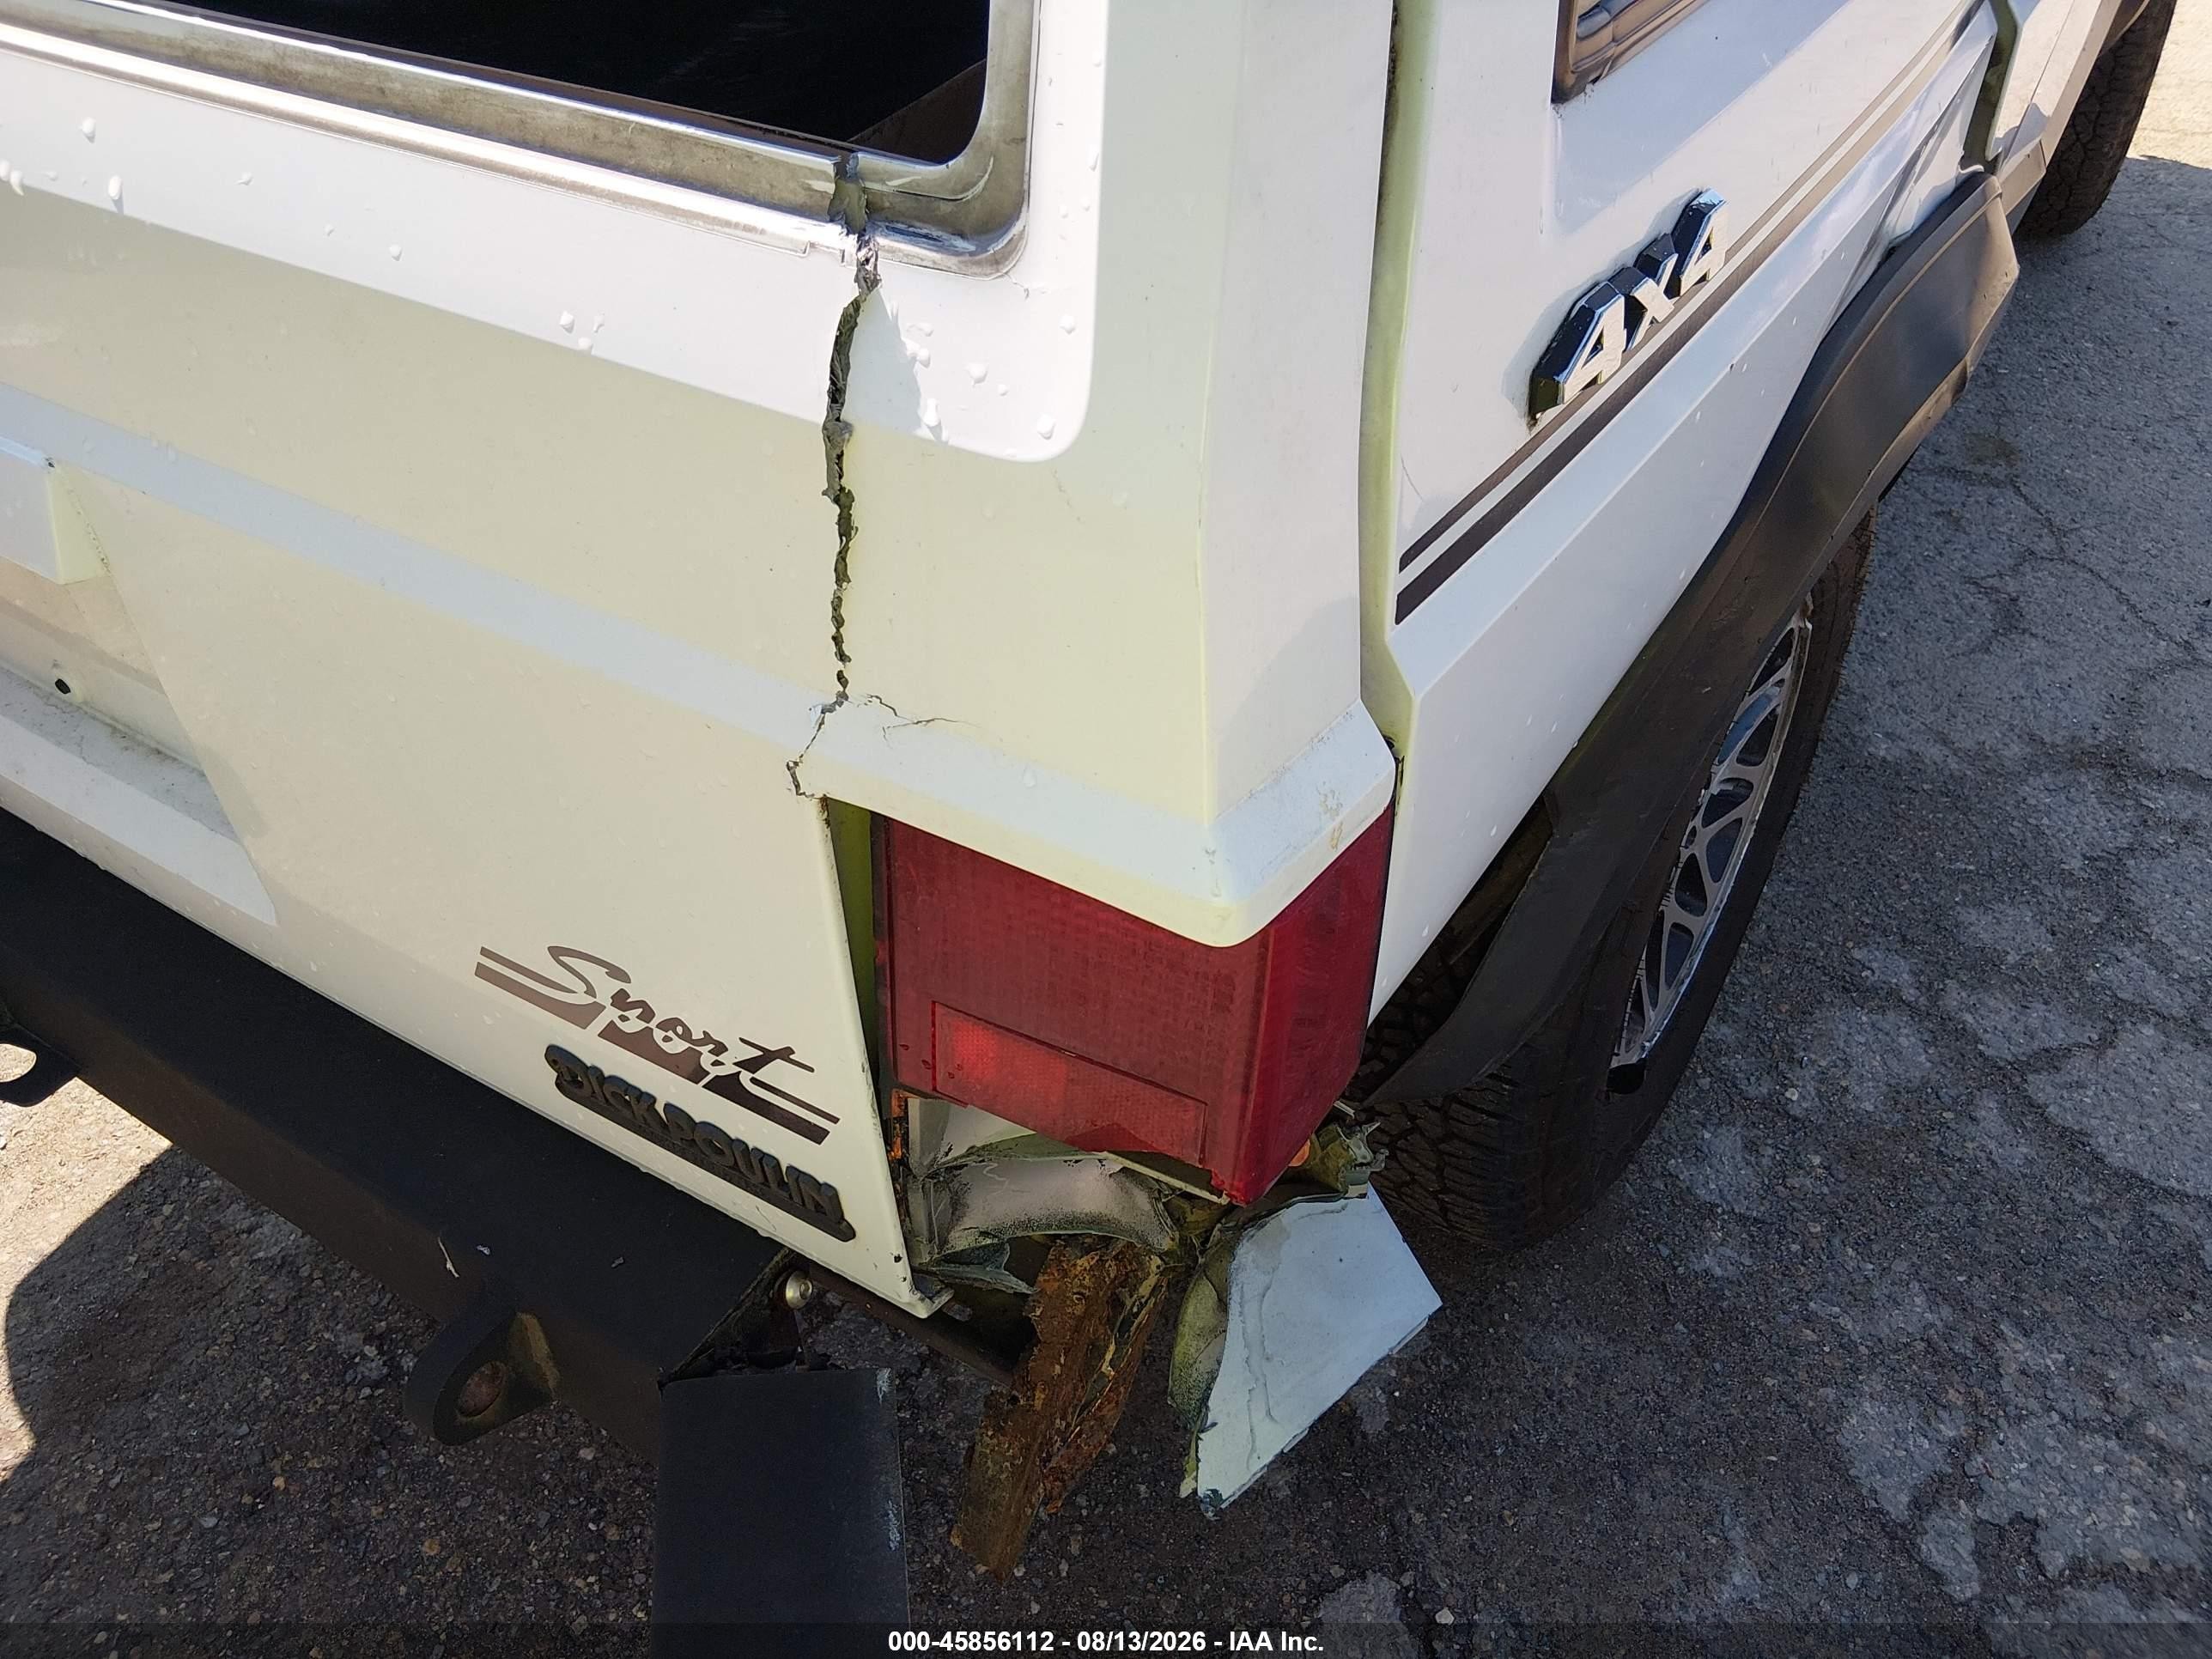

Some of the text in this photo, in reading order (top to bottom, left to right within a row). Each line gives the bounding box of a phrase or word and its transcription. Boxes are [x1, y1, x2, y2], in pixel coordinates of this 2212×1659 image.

[478, 945, 841, 1126] Sport
[544, 1044, 669, 1132] DICK
[664, 1103, 847, 1222] POULIN
